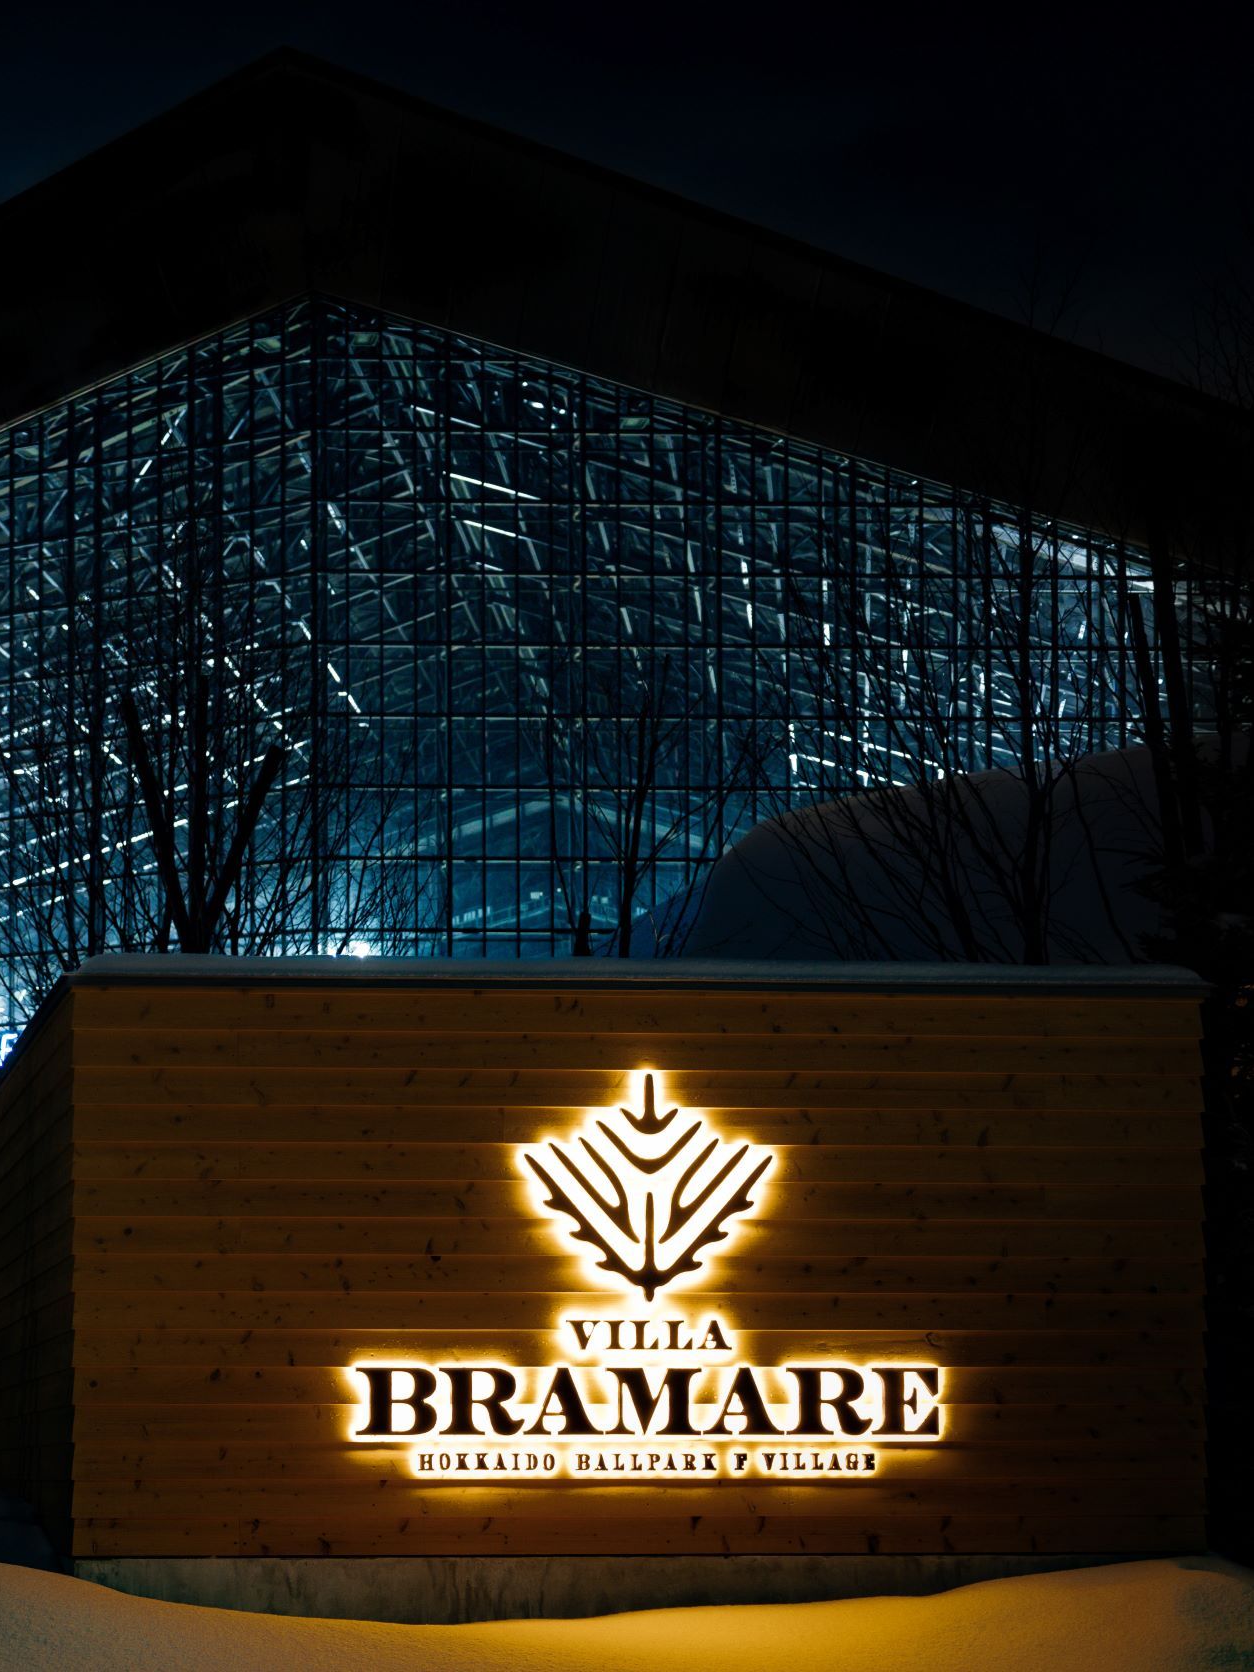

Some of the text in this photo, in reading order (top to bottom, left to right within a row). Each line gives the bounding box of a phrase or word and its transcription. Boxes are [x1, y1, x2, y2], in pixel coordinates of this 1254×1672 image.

[565, 1319, 732, 1350] VILLA
[354, 1366, 940, 1437] BRAMARE
[418, 1452, 876, 1472] HOKKAIDO BALLPARK F VILLAGE
